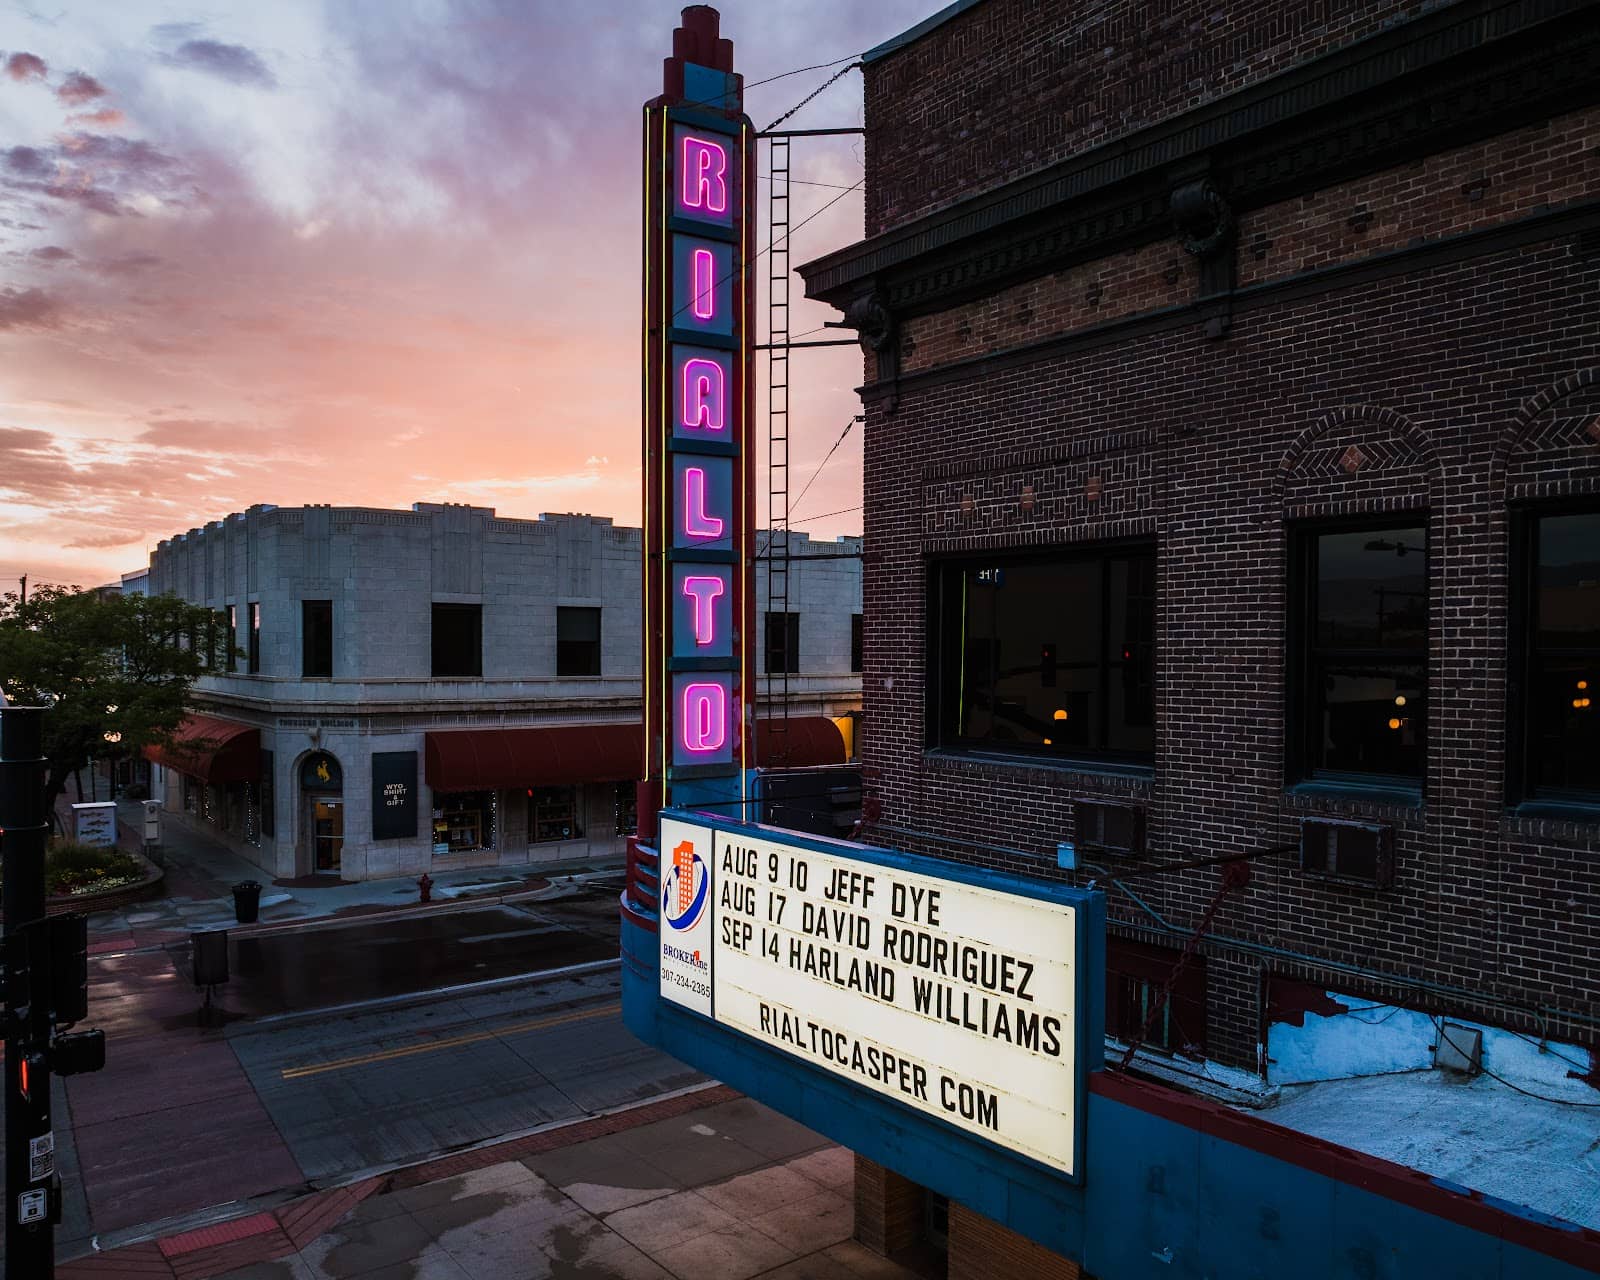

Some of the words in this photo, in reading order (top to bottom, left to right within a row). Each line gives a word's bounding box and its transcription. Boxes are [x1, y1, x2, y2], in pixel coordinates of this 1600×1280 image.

[683, 136, 726, 752] RIALTO
[721, 880, 756, 917] AUG
[768, 892, 787, 925] 17
[802, 902, 870, 951] DAVID
[884, 924, 1034, 1002] RODRIGUEZ
[722, 844, 758, 880] AUG
[768, 853, 779, 883] 9
[789, 858, 808, 892] 10
[824, 868, 875, 909] JEFF
[891, 882, 941, 927] DYE
[661, 968, 711, 998] 307-234-2385
[722, 916, 753, 951] SEP
[762, 928, 780, 963] 14
[789, 937, 895, 1003] HARLAND
[912, 975, 1061, 1057] WILLIAMS
[760, 1002, 928, 1101] RIALTOCASPER
[940, 1076, 999, 1131] COM
